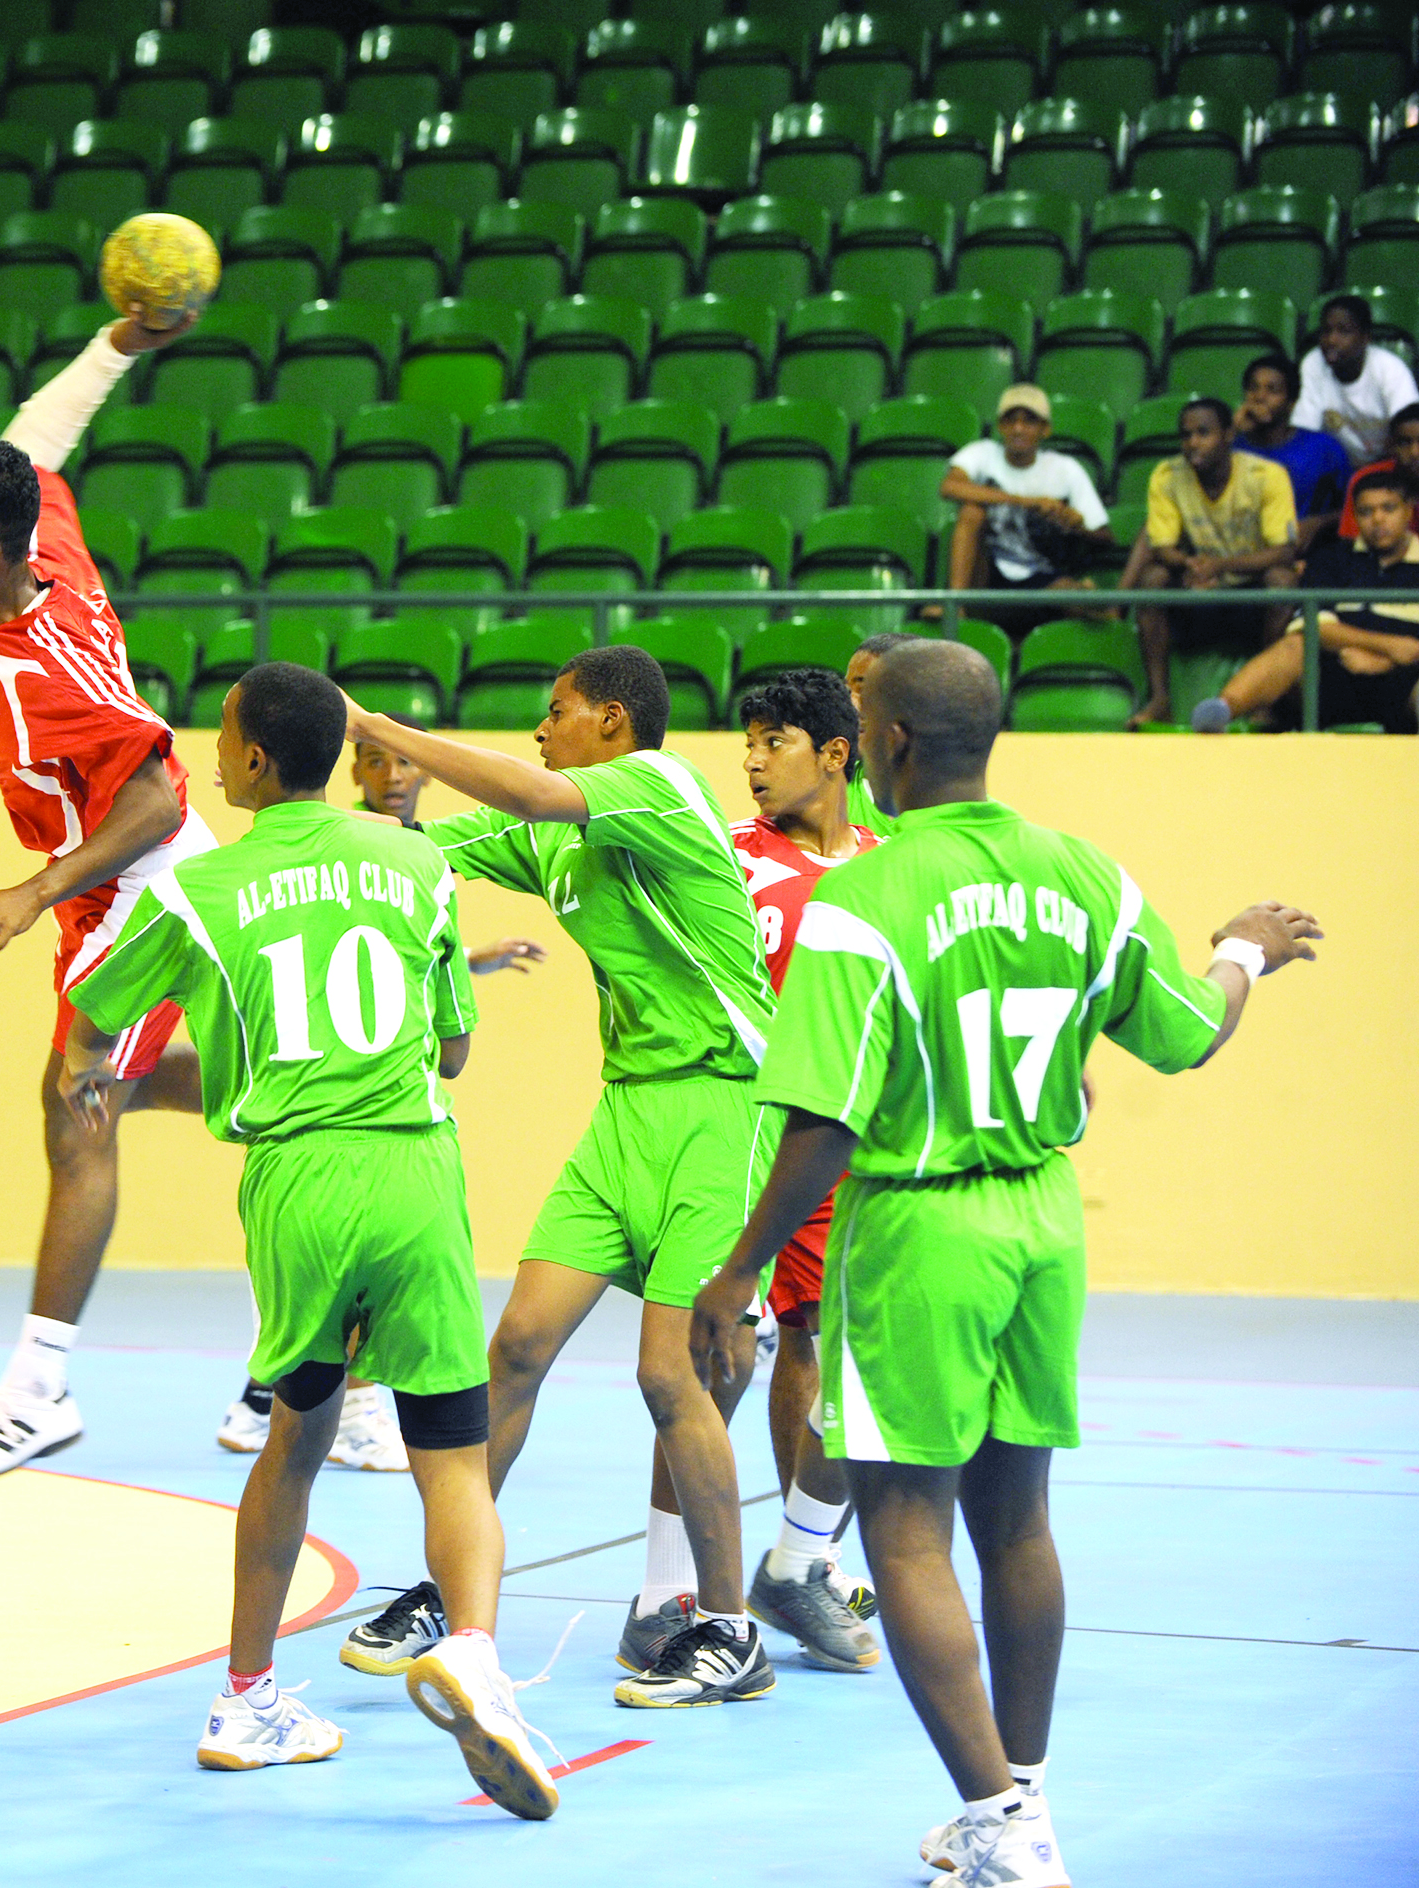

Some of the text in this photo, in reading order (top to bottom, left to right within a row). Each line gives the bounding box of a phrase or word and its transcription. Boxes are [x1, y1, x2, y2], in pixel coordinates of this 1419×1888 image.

[237, 860, 414, 930] AL-ETIFAQ CLUB
[547, 871, 581, 916] 12
[1035, 886, 1089, 955] CLUB
[257, 925, 406, 1061] 10
[956, 987, 1078, 1128] 17
